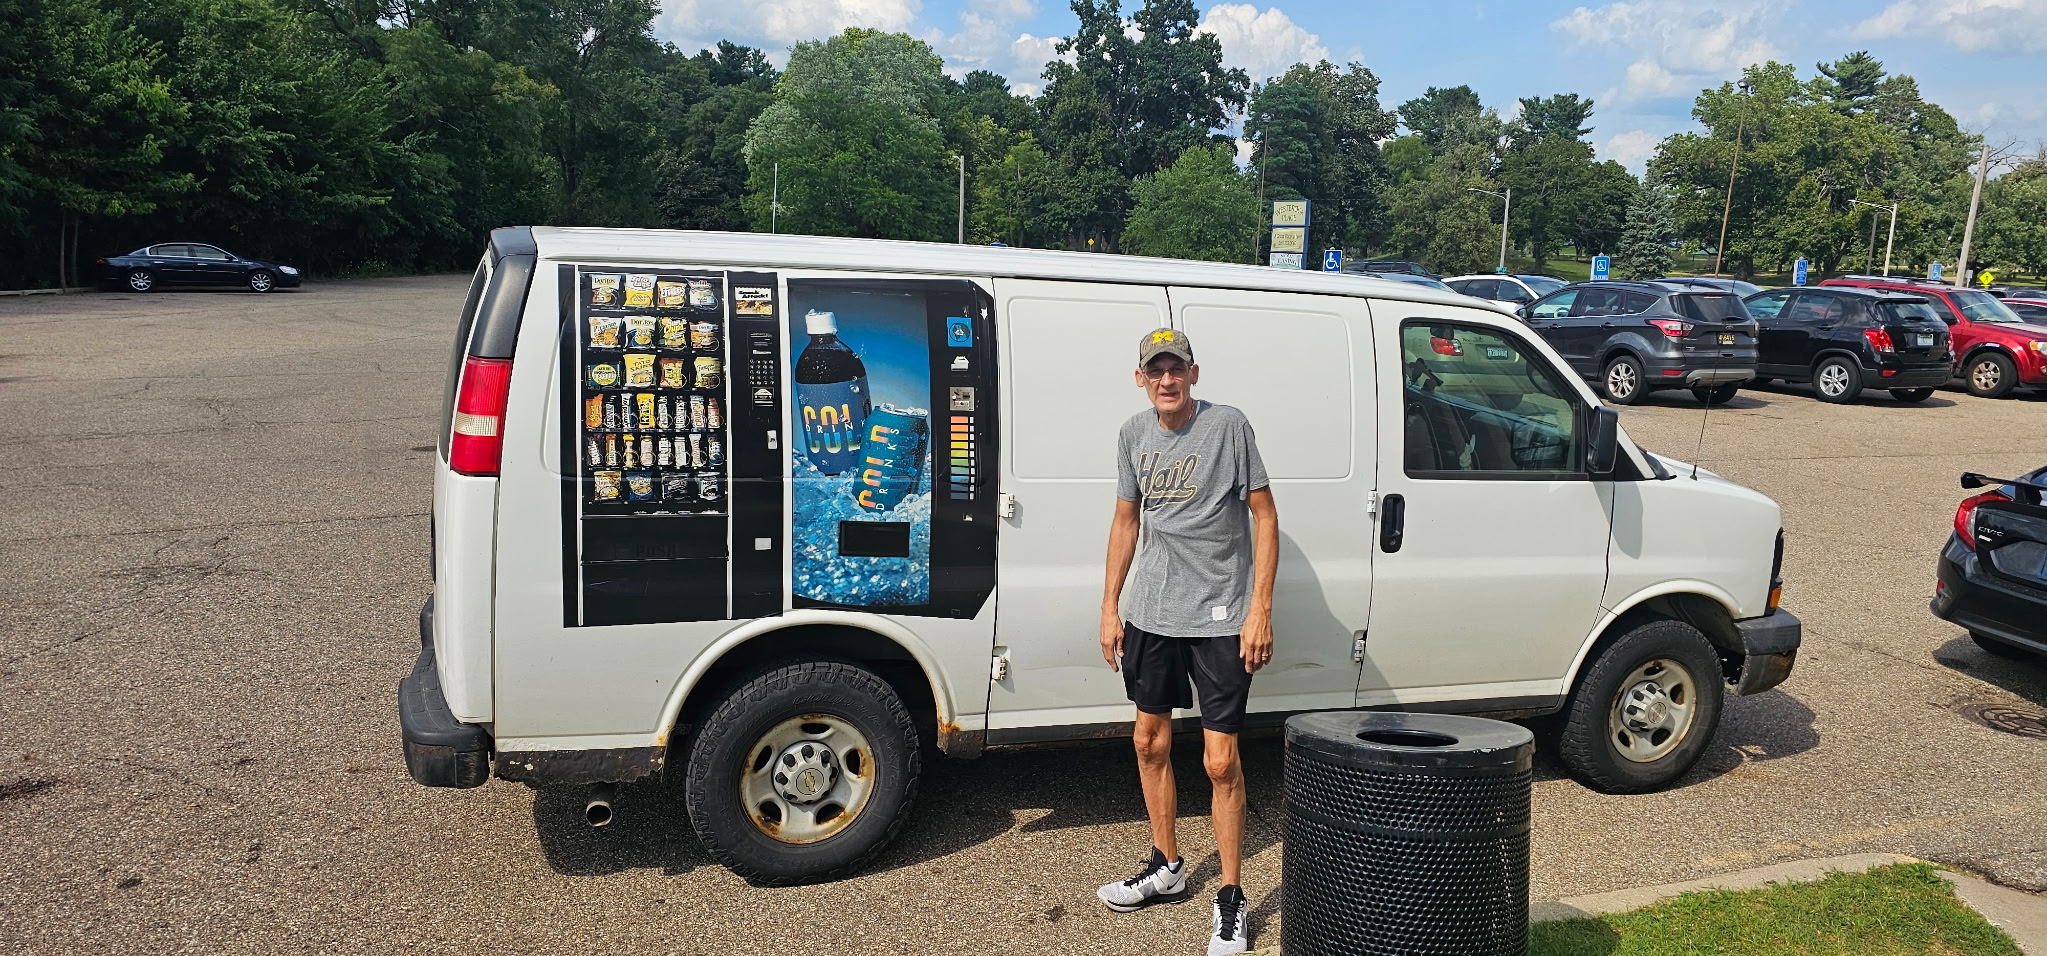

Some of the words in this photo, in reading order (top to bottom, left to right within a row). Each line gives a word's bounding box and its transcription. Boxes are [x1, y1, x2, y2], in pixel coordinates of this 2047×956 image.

[594, 277, 616, 285] Doritos
[631, 318, 654, 326] Doritos
[1152, 331, 1174, 344] M
[691, 402, 703, 427] CRUNCH
[875, 428, 900, 511] DRINKS
[1137, 451, 1199, 503] Hail
[1978, 526, 2005, 537] CIVIC
